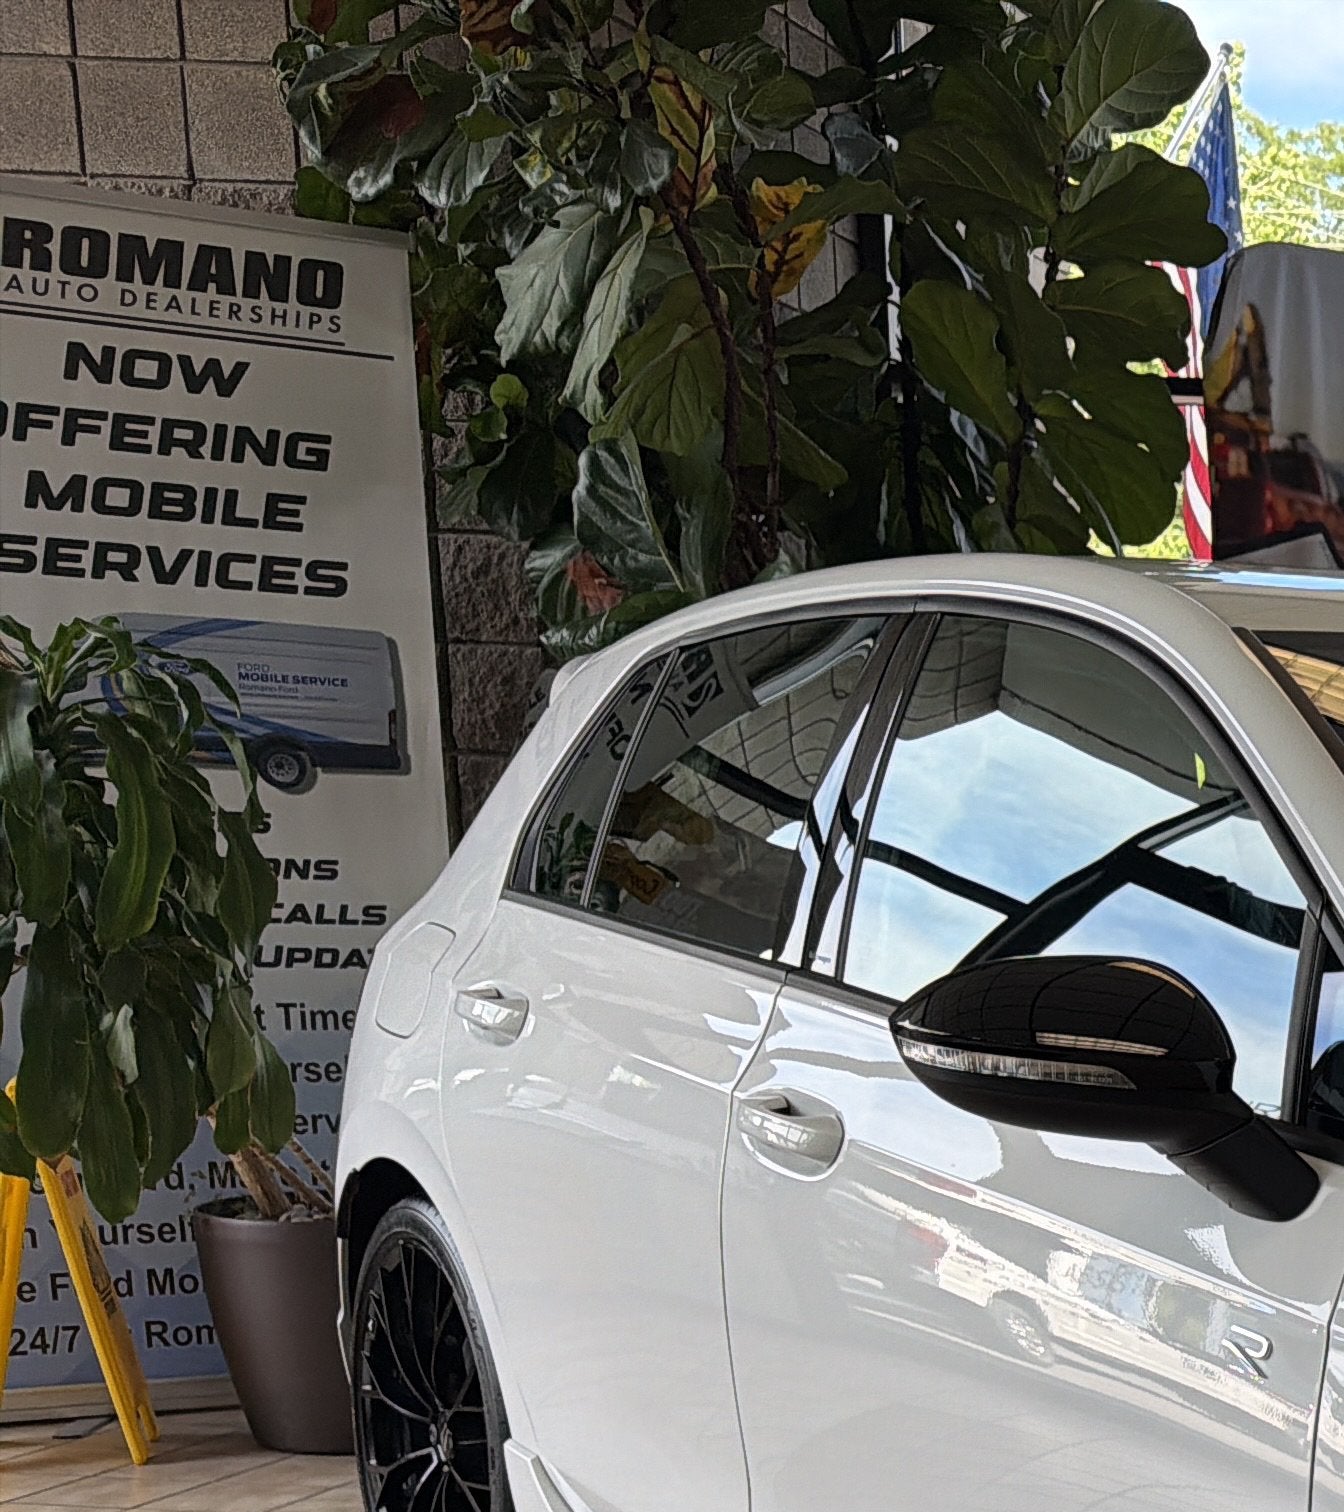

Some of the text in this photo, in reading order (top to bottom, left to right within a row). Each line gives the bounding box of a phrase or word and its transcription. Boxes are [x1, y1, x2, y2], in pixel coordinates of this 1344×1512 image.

[1, 216, 344, 310] ROMANO
[4, 274, 342, 334] AUTO DEALERSHIPS
[63, 341, 250, 398] NOW
[0, 402, 332, 471] FFERING
[24, 470, 307, 532] MOBILE
[0, 534, 348, 598] SERVICES
[237, 663, 270, 673] FORD
[237, 672, 349, 688] MOBILE SERVICE
[278, 685, 299, 694] Ford
[254, 945, 377, 969] UPDA
